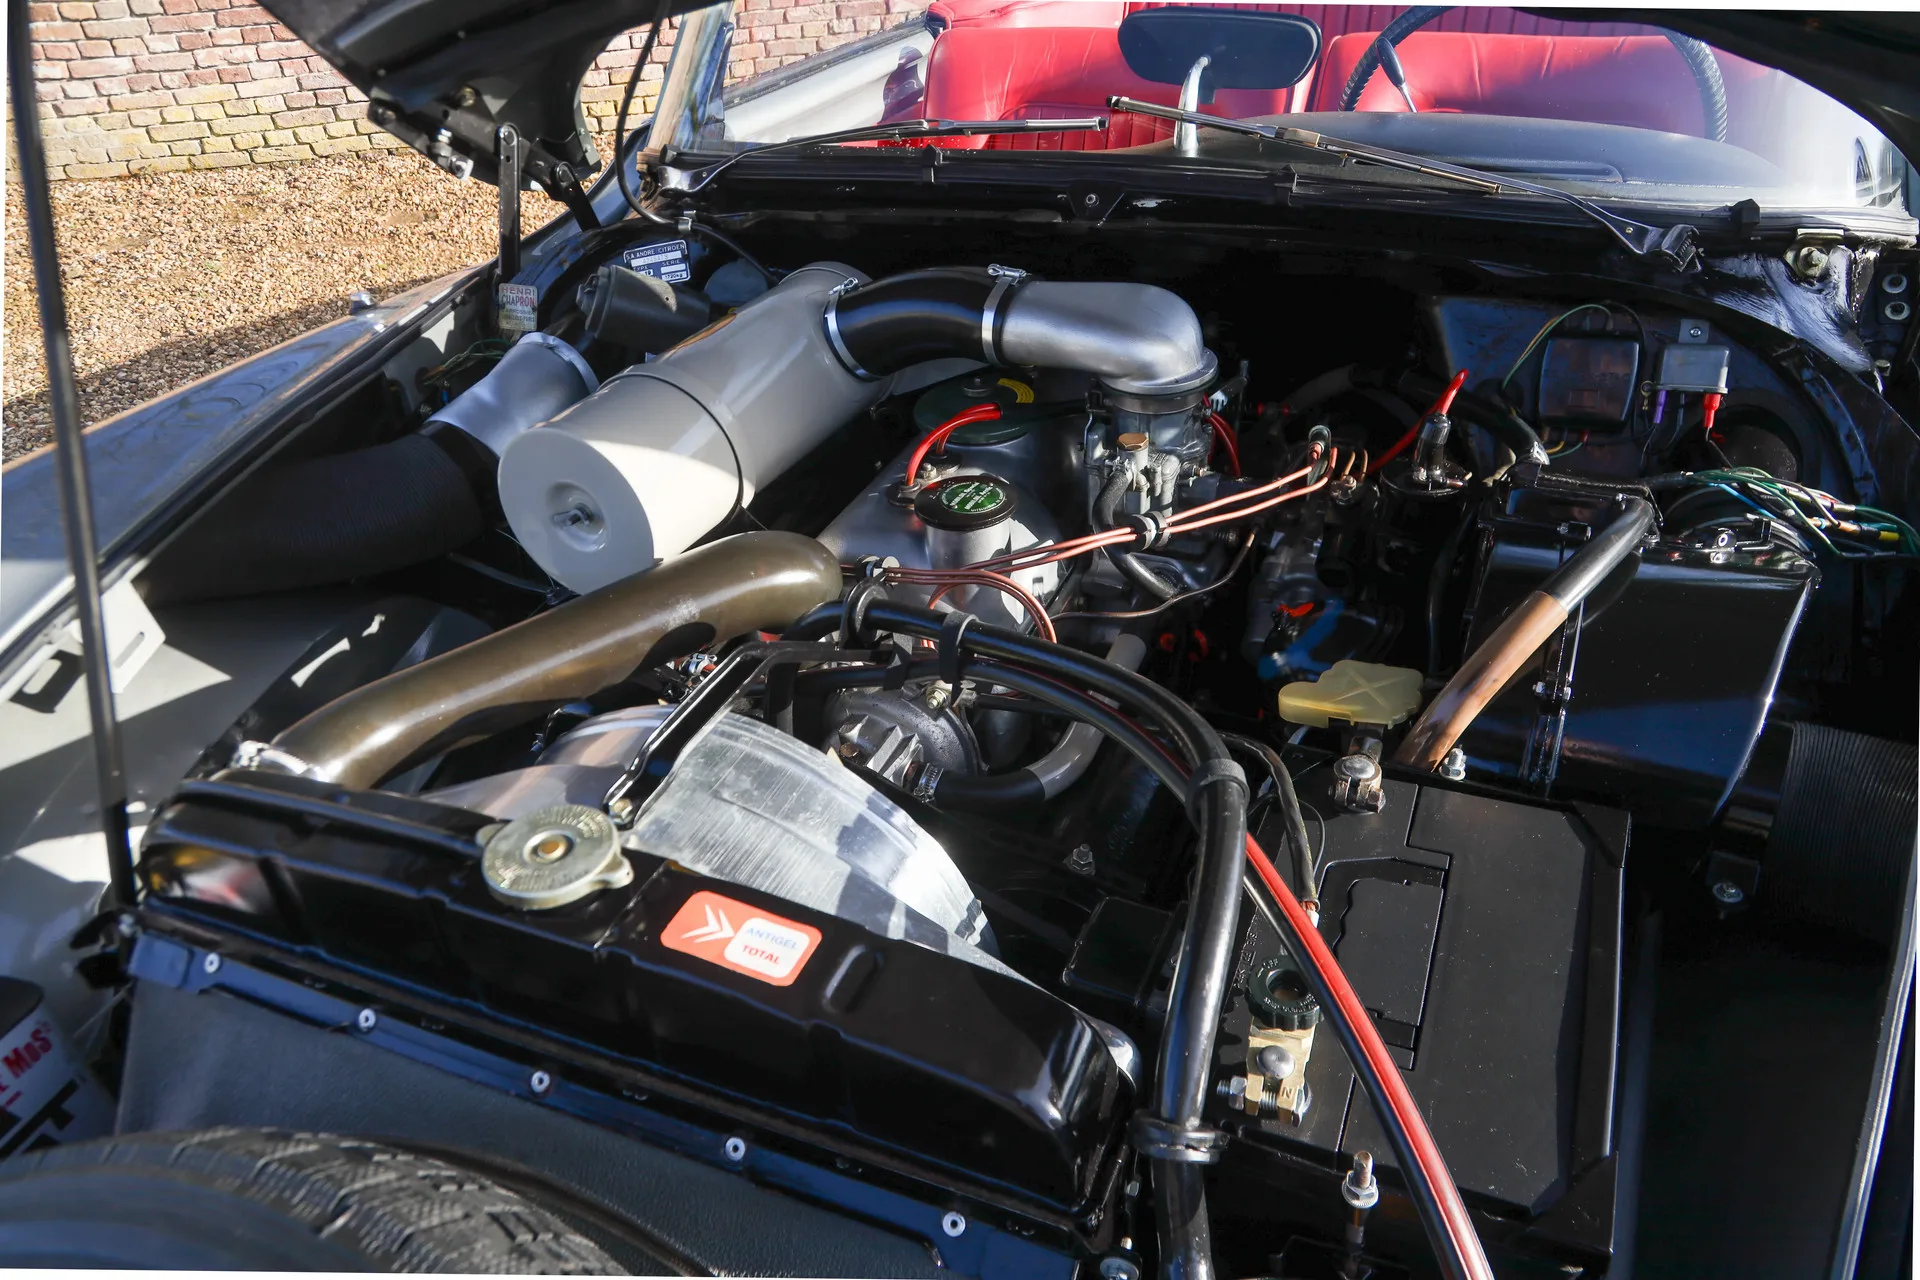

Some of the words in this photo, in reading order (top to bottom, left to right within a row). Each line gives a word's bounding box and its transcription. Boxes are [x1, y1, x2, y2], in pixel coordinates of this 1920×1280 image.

[636, 249, 656, 258] ANDRE
[501, 287, 535, 296] HENRI
[501, 294, 535, 308] CHAPRON
[746, 927, 797, 949] ANTIGEL
[742, 944, 779, 964] TOTAL
